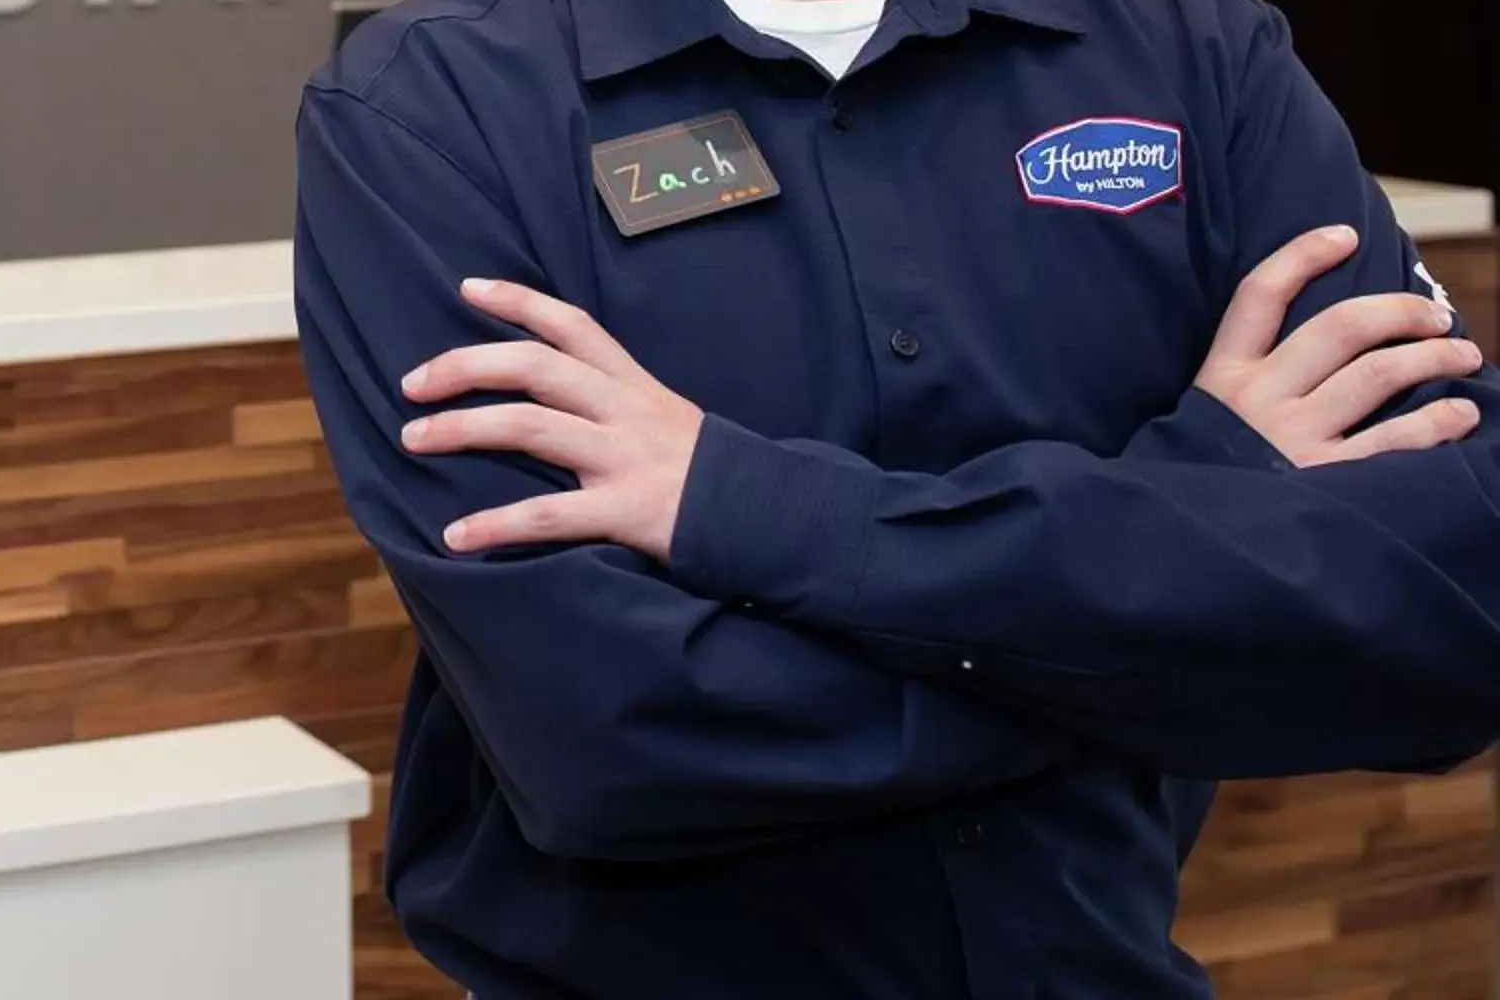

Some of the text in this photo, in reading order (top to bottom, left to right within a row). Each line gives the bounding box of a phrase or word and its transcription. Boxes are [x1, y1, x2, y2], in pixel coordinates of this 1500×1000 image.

[613, 139, 737, 204] Zach
[1026, 139, 1177, 185] Hampton
[1076, 176, 1145, 193] by HILTON
